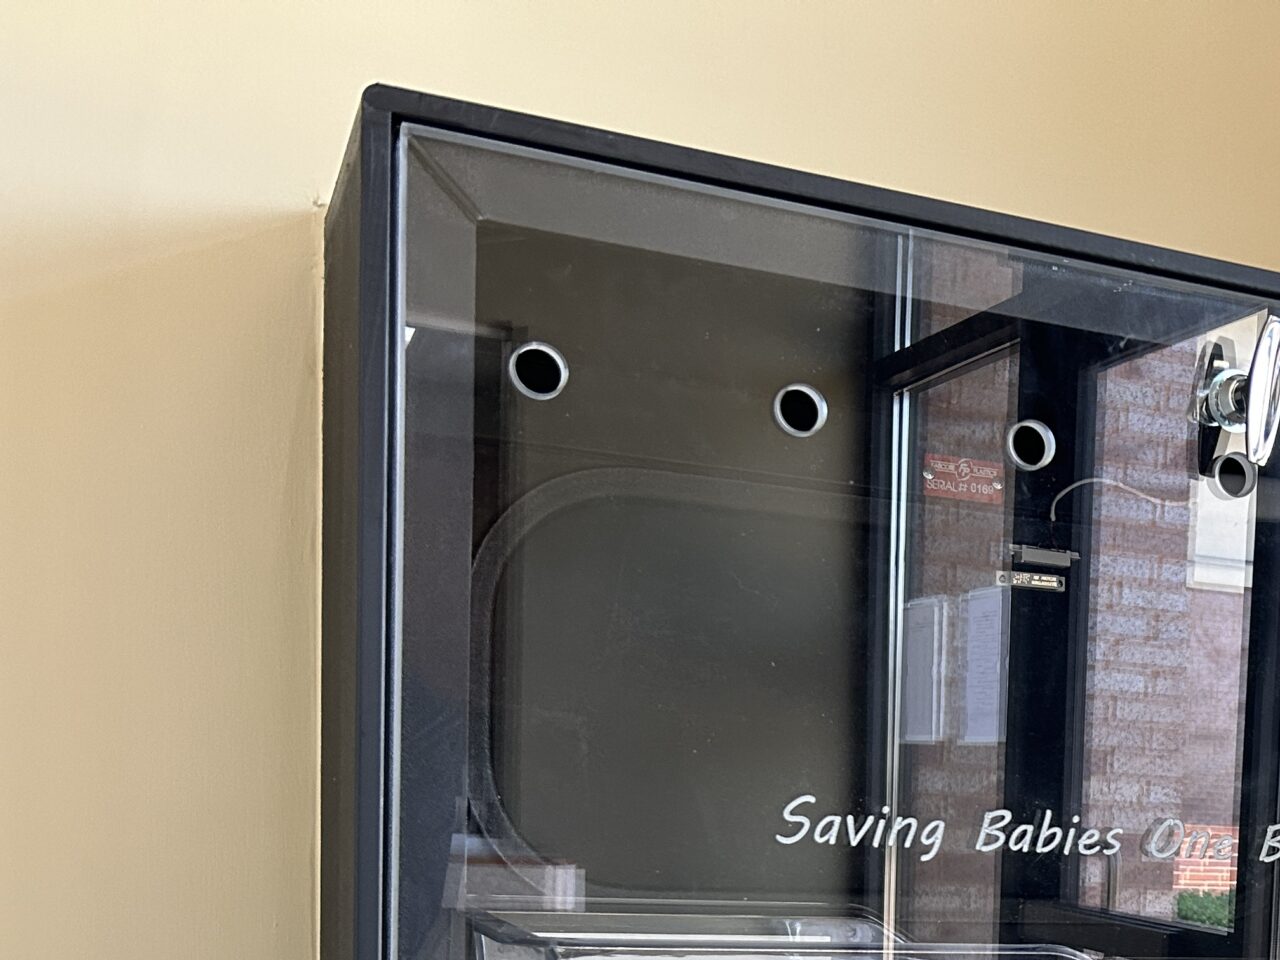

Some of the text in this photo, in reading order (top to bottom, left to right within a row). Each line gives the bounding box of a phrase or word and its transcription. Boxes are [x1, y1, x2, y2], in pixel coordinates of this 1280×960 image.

[926, 480, 958, 493] SERIAL
[959, 483, 968, 492] #
[775, 794, 945, 862] Saving
[975, 808, 1123, 856] Babies
[1146, 817, 1233, 860] One
